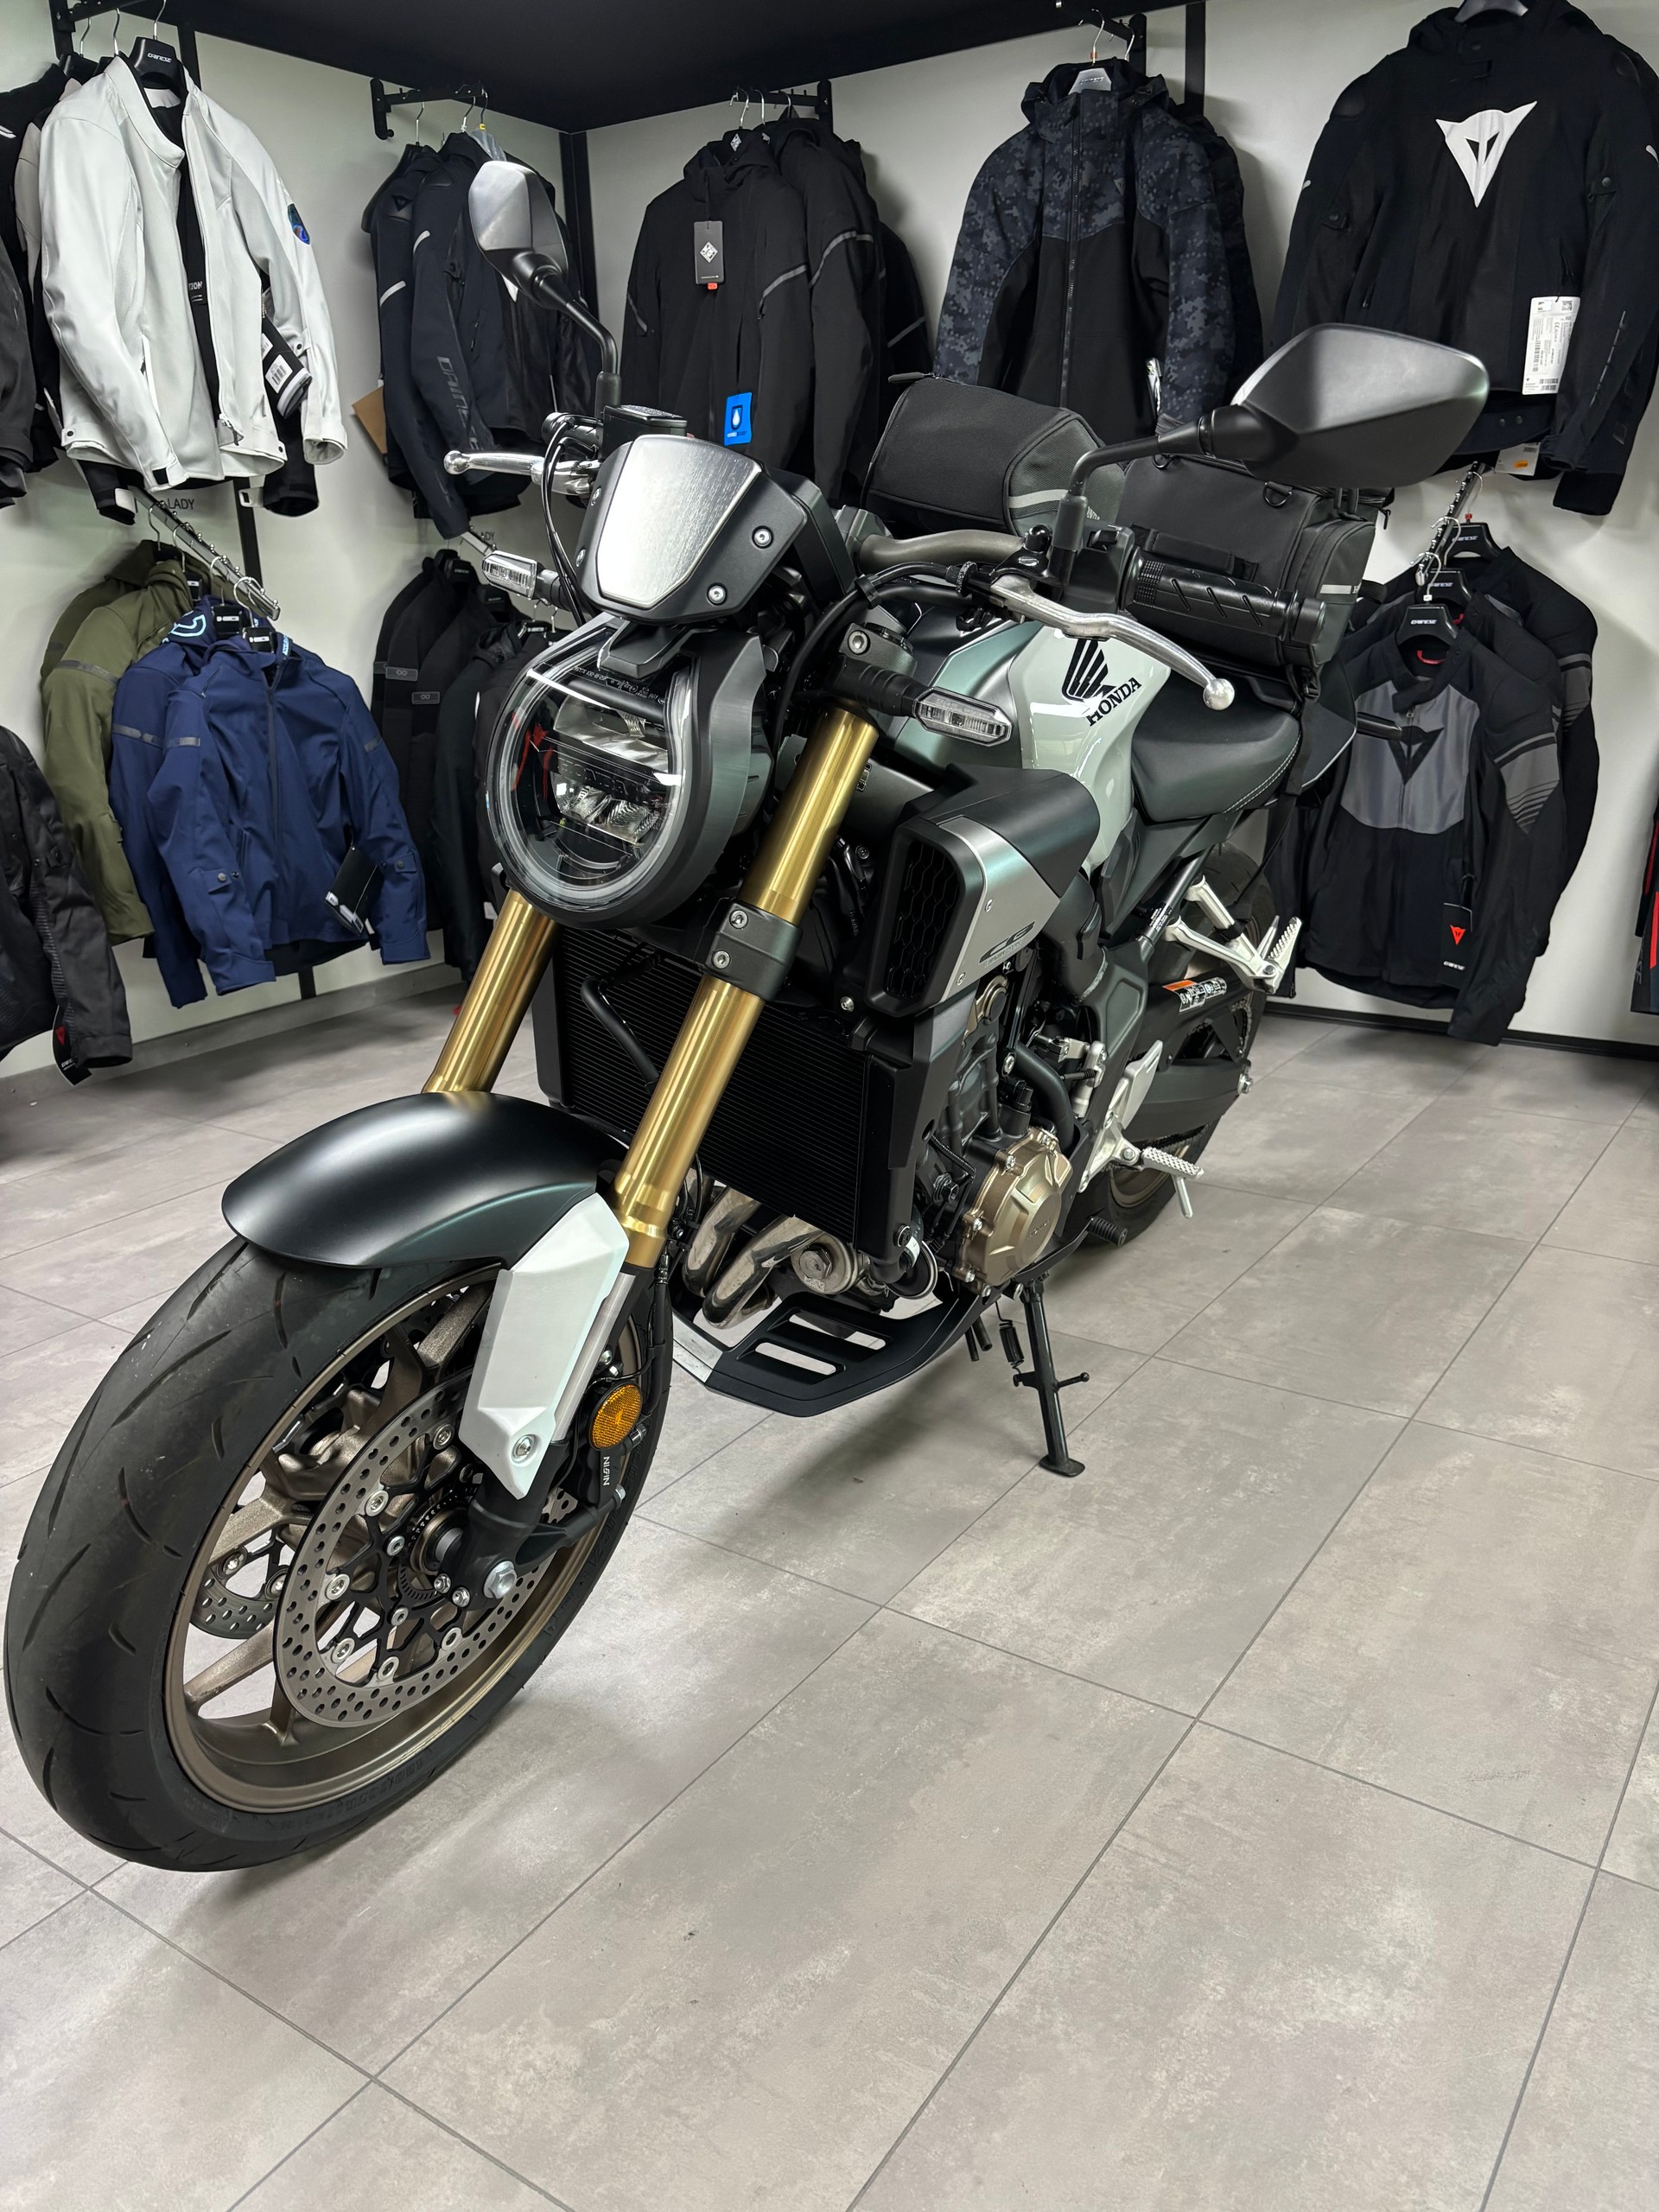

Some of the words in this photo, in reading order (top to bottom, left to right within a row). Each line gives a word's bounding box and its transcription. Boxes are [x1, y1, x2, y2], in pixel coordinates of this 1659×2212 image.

[436, 356, 485, 450] DAINEE
[167, 498, 194, 510] LADY
[1086, 677, 1142, 727] HONDA
